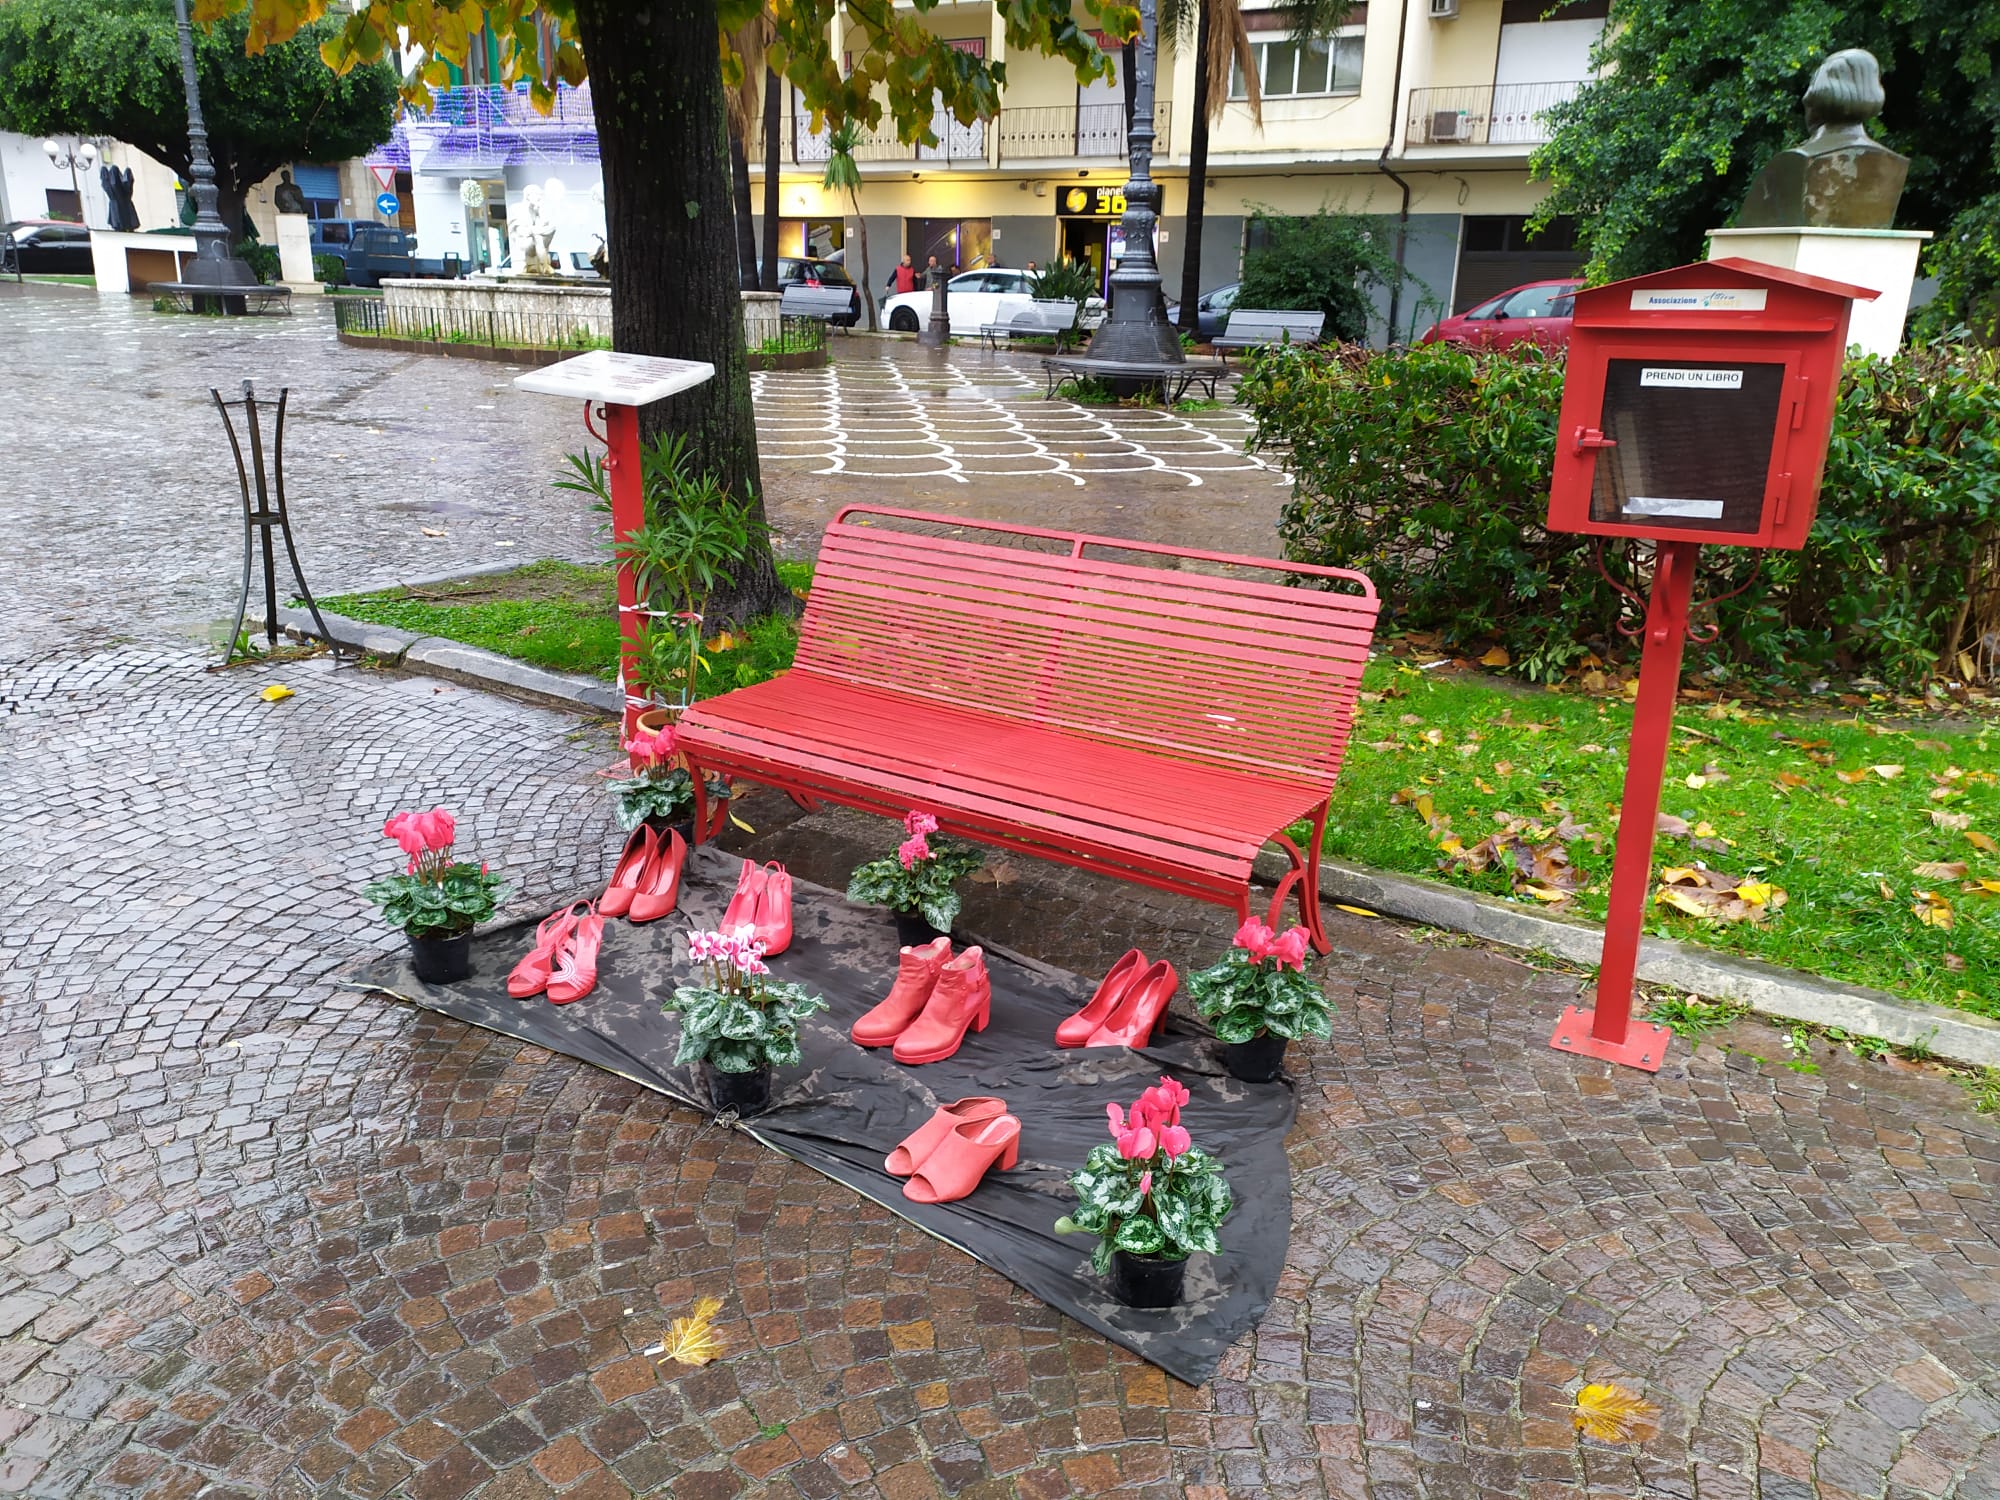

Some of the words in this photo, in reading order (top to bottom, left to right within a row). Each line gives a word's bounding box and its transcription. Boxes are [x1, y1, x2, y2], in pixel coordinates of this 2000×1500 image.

[1648, 296, 1697, 304] Associazione
[1645, 371, 1685, 381] PRENDI
[1688, 372, 1703, 381] UN
[1705, 373, 1739, 382] LIBRO
